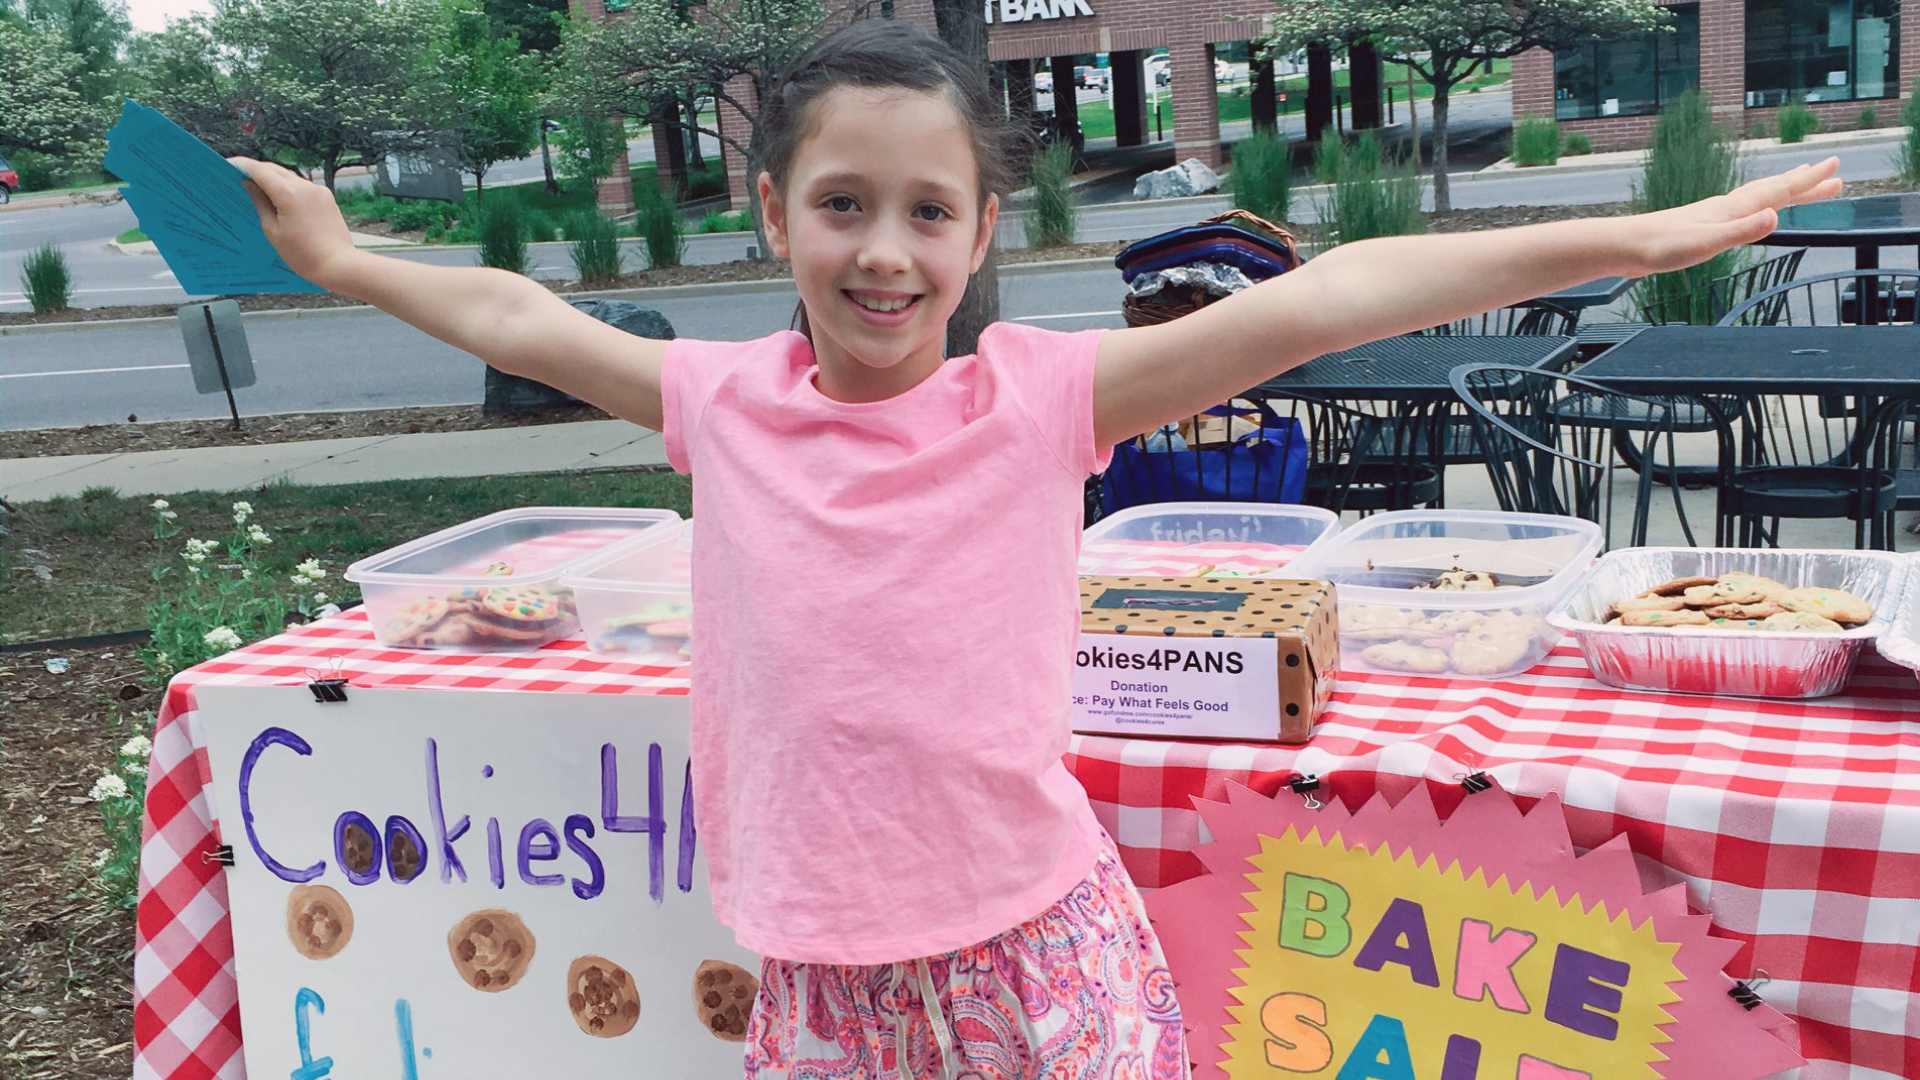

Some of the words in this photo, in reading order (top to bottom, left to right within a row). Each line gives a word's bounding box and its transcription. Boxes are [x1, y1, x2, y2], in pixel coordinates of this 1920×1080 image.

[1076, 646, 1243, 674] okies4PANS
[1110, 680, 1168, 693] Donation
[1092, 695, 1117, 709] Pay
[1119, 697, 1152, 709] What
[1156, 698, 1190, 710] Feels
[1194, 700, 1229, 712] Good
[239, 726, 697, 904] Cookies4
[1278, 871, 1631, 1041] BAKE
[1260, 991, 1592, 1080] SA
